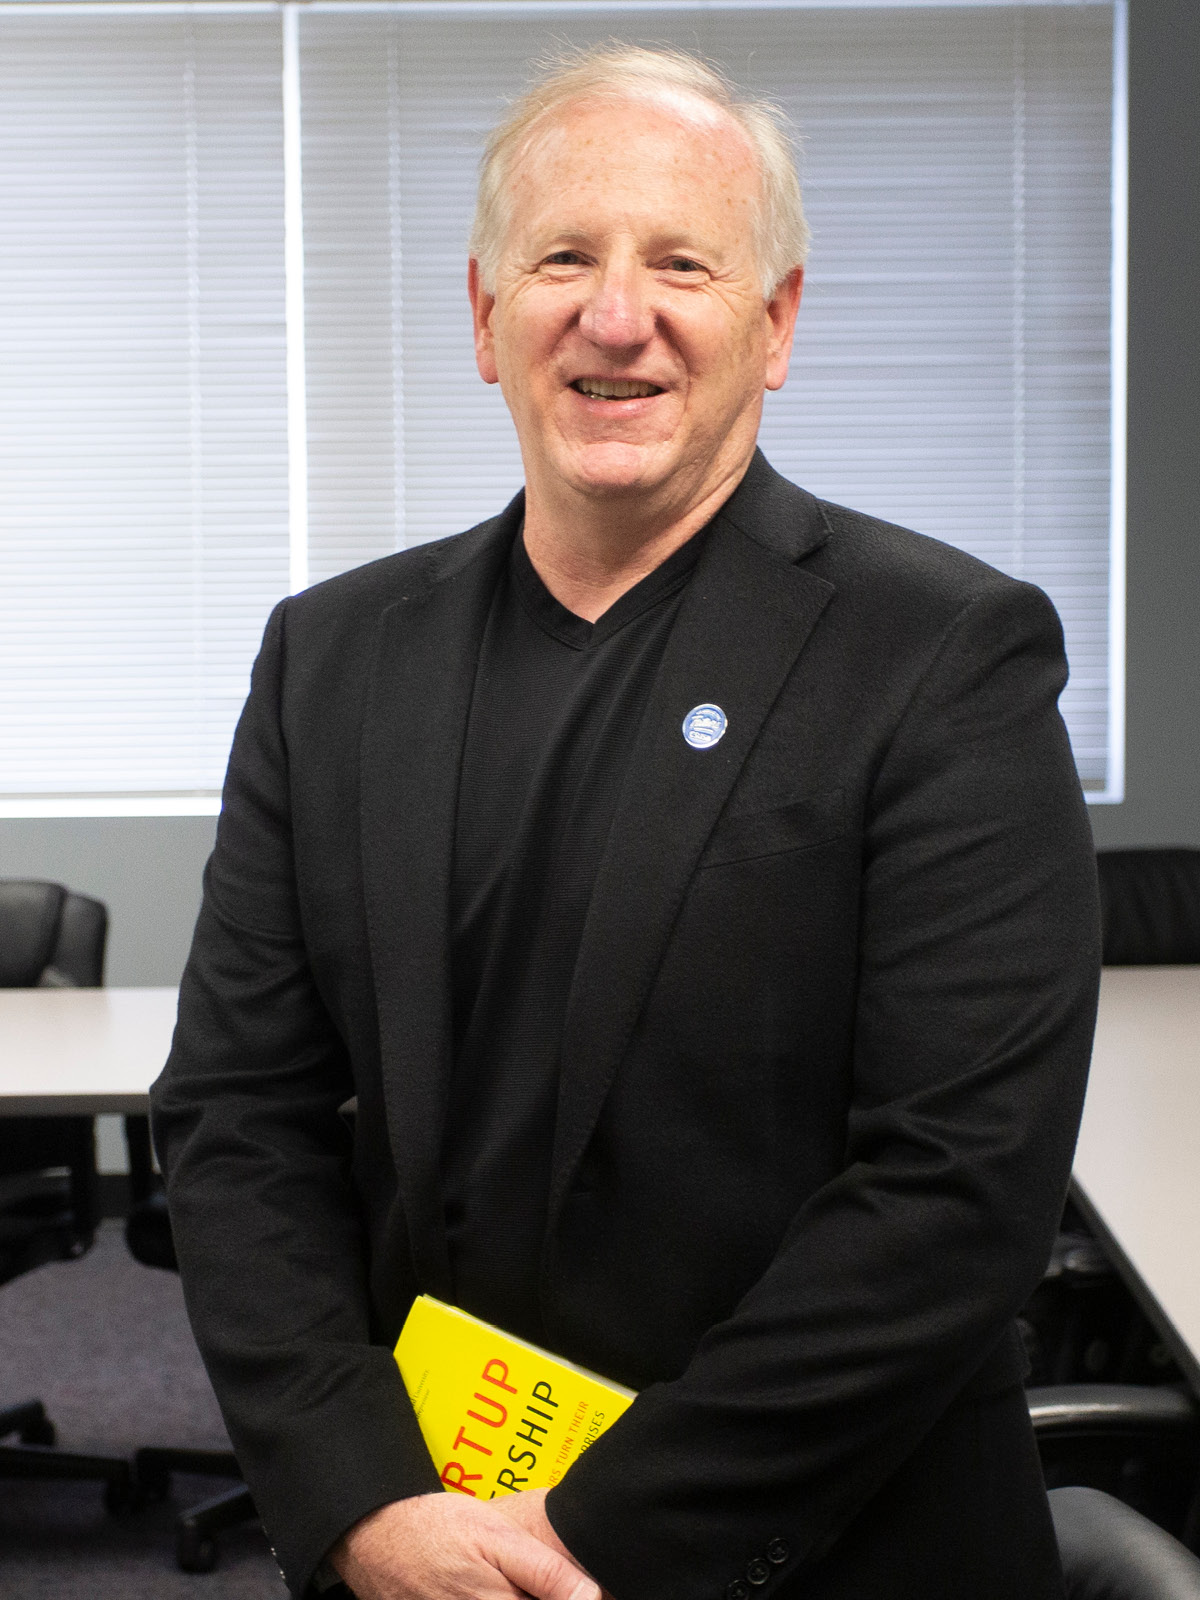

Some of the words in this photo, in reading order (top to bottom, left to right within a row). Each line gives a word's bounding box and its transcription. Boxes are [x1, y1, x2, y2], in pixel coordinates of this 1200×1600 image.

[490, 1381, 559, 1500] RSHIP
[556, 1436, 575, 1465] TURN
[569, 1401, 589, 1433] THEIR
